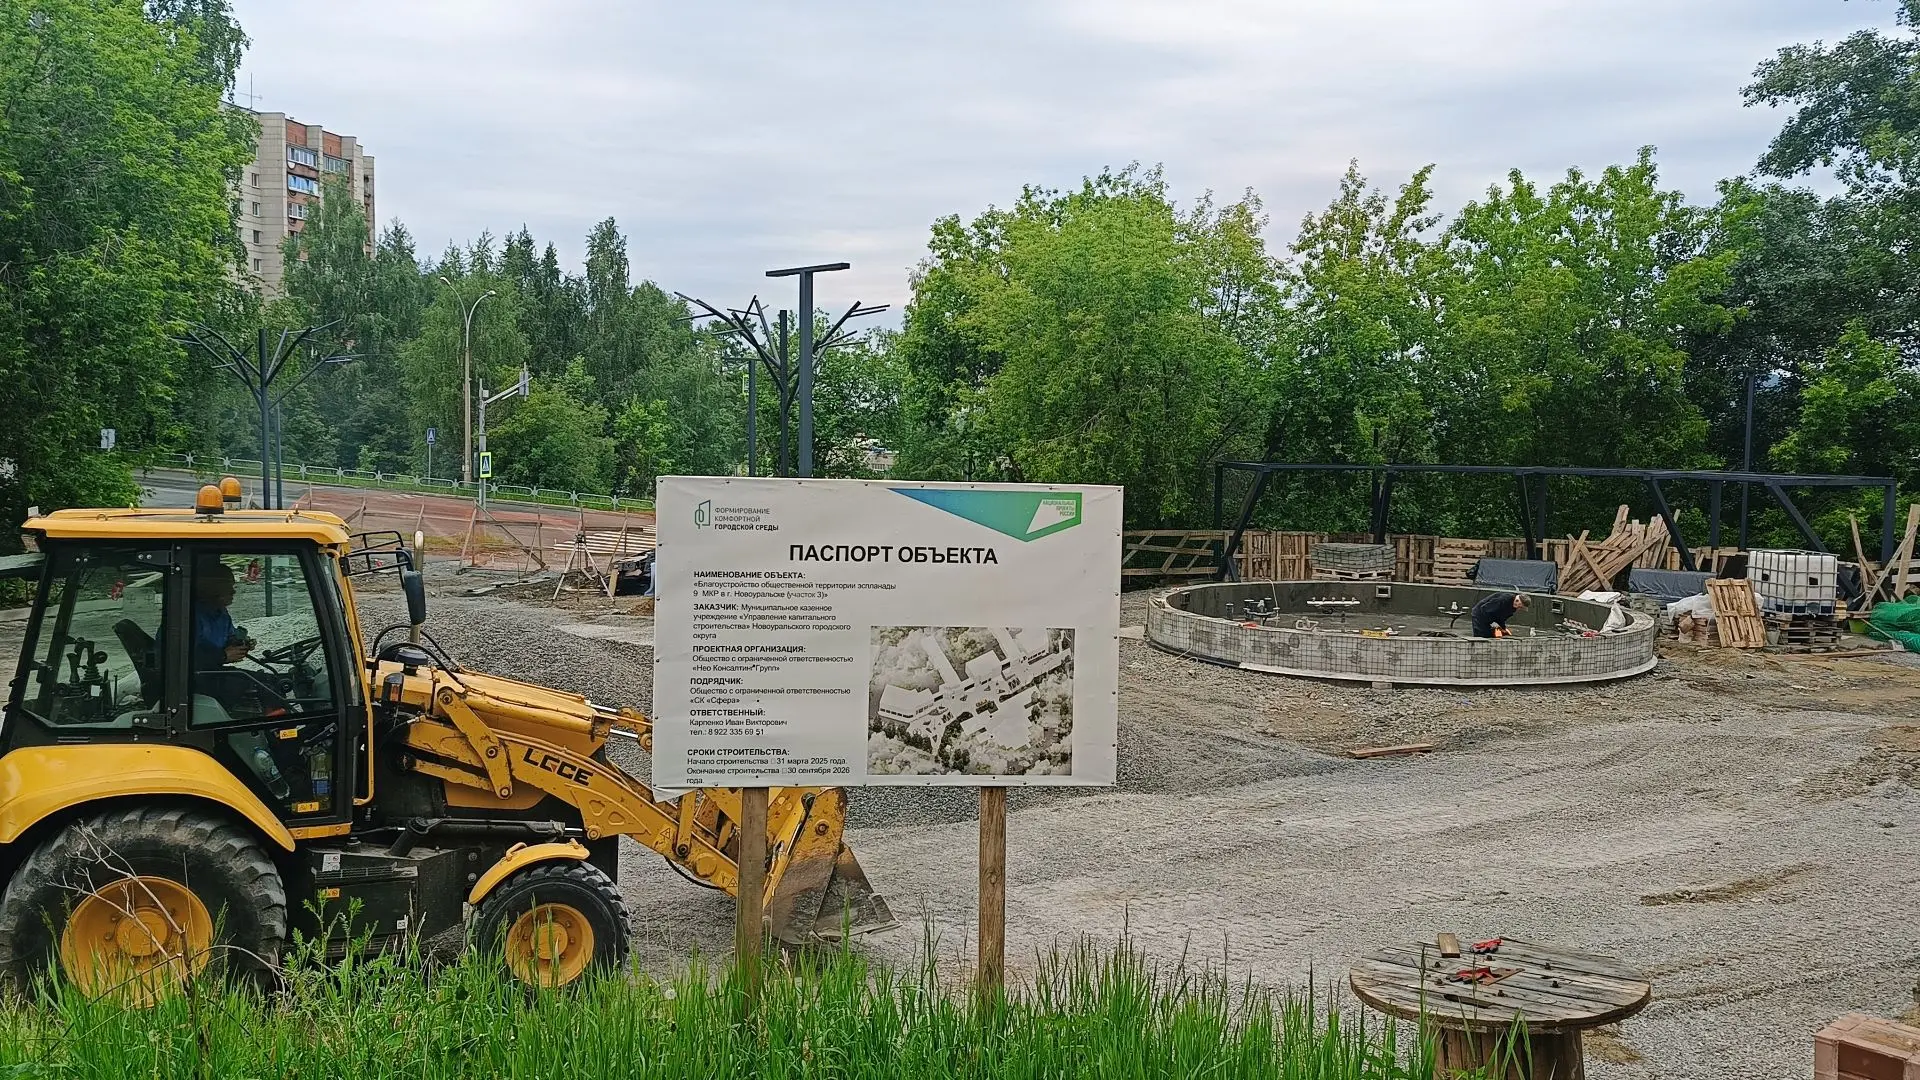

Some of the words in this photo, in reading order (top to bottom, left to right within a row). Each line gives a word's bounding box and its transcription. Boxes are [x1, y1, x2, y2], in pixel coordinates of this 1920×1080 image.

[714, 507, 770, 515] ФОРМИРОВАНИЕ
[714, 515, 761, 523] КОМФОРТНОЙ
[714, 523, 754, 531] ГОРОДСКОЙ
[755, 524, 779, 532] СРЕДЫ
[789, 544, 894, 563] ПАСПОРТ
[898, 546, 999, 565] ОБЪЕКТА
[763, 571, 806, 579] ОБЪЕКТА:
[693, 580, 760, 589] «Благоустройство
[760, 581, 814, 590] общественной
[815, 582, 856, 591] территории
[857, 582, 897, 591] эспланады
[734, 590, 785, 599] Новоуральске
[786, 590, 816, 599] (участок
[693, 603, 739, 611] ЗАКАЗЧИК:
[741, 604, 799, 612] Муниципальное
[693, 613, 738, 621] учреждение
[739, 613, 788, 621] «Управление
[752, 622, 811, 631] Новоуральского
[692, 632, 717, 640] округа
[692, 645, 743, 653] ПРОЕКТНАЯ
[743, 645, 806, 654] ОРГАНИЗАЦИЯ:
[692, 654, 730, 662] Общество
[737, 656, 788, 664] ограниченной
[692, 664, 712, 672] «Нео
[690, 677, 744, 686] ПОДРЯДЧИК:
[689, 687, 728, 695] Общество
[734, 688, 785, 696] ограниченной
[706, 696, 741, 705] «Сфера»
[689, 708, 766, 717] ОТВЕТСТВЕННЫЙ:
[689, 719, 724, 727] Карпенко
[745, 718, 788, 727] Викторович
[707, 728, 714, 736] 8
[713, 728, 729, 736] 922
[729, 728, 744, 736] 335
[744, 728, 755, 736] 69
[687, 748, 716, 756] СРОКИ
[716, 748, 790, 756] СТРОИТЕЛЬСТВА:
[786, 758, 809, 766] марта
[810, 757, 829, 765] 2025
[686, 767, 726, 775] Окончание
[727, 768, 780, 776] строительства
[797, 767, 832, 775] сентября
[832, 766, 851, 774] 2026
